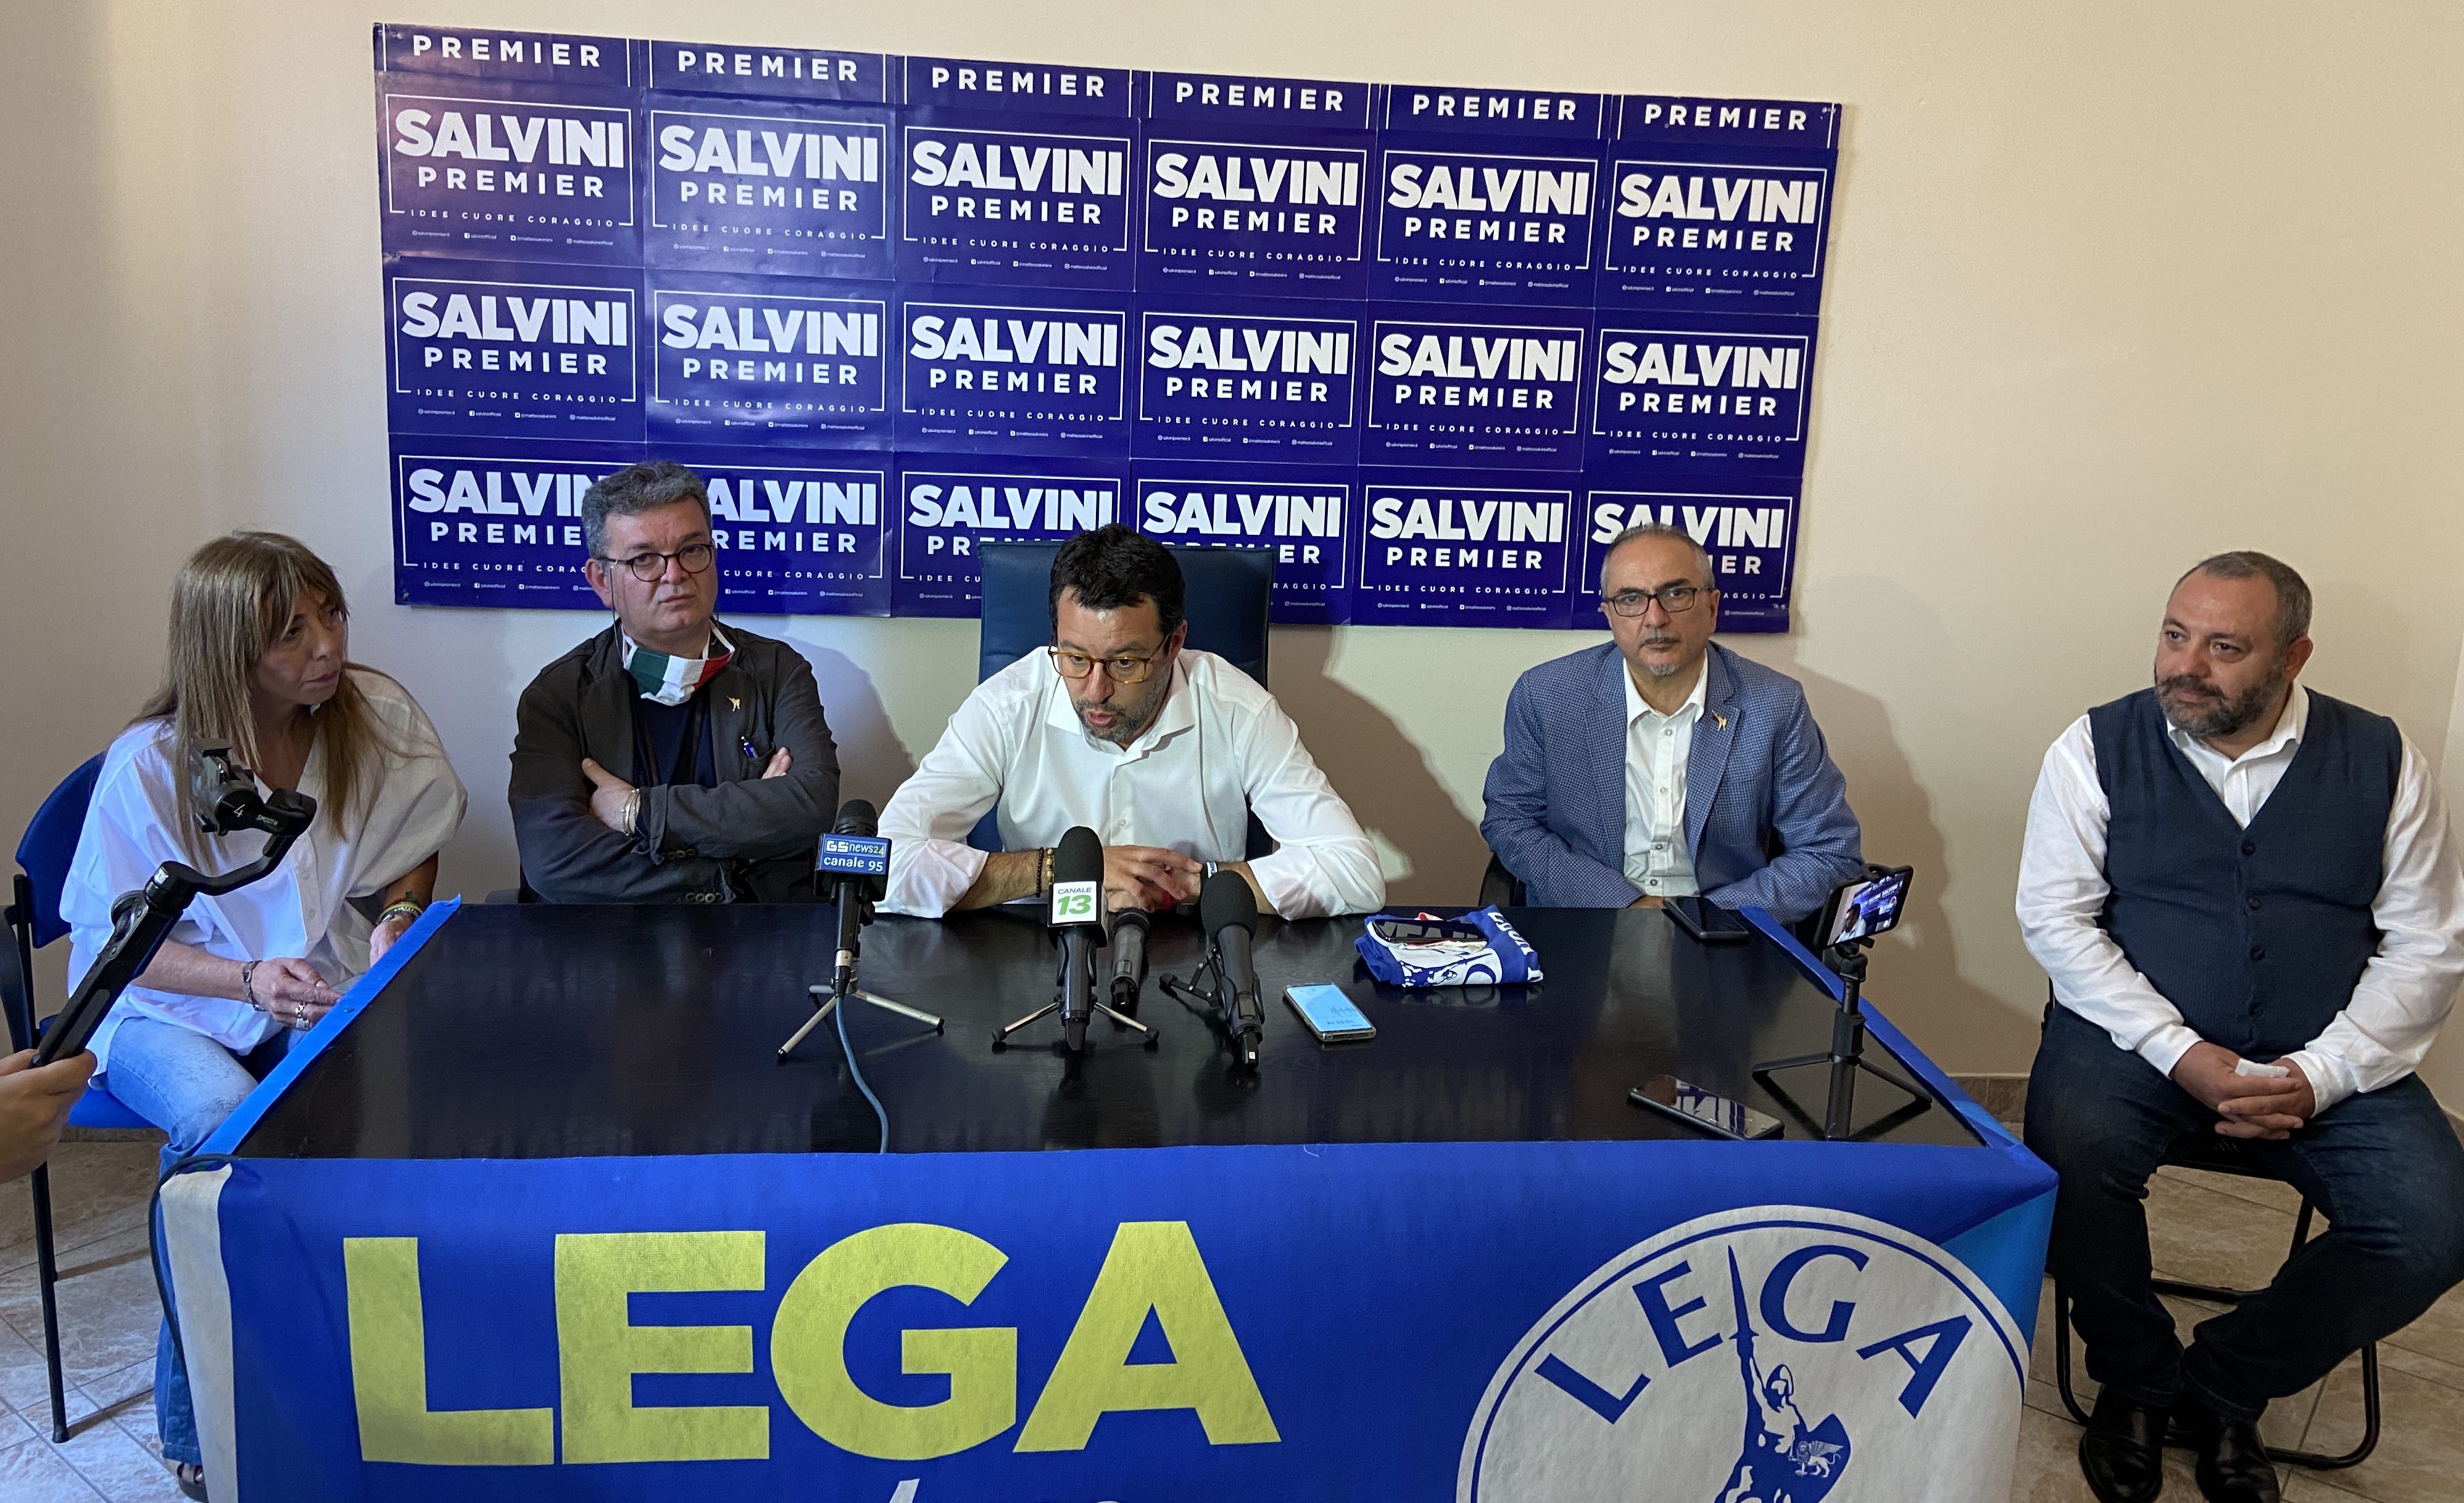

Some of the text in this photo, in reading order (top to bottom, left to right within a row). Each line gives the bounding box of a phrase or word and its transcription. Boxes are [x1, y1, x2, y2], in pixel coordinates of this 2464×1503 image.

[413, 35, 599, 67] PREMIER
[679, 51, 857, 81] PREMIER
[933, 68, 1103, 96] PREMIER
[1177, 83, 1342, 110] PREMIER
[1413, 95, 1575, 120] PREMIER
[1645, 104, 1806, 130] PREMIER
[394, 109, 623, 168] SALVINI
[658, 125, 877, 182] SALVINI
[911, 140, 1122, 196] SALVINI
[1153, 153, 1358, 206] SALVINI
[418, 166, 603, 197] PREMIER
[1387, 164, 1589, 215] SALVINI
[681, 181, 857, 211] PREMIER
[1617, 173, 1818, 224] SALVINI
[411, 209, 612, 226] IDEE CUORE CORAGGIO
[931, 195, 1100, 224] PREMIER
[1172, 207, 1336, 234] PREMIER
[673, 223, 865, 240] IDEE CUORE CORAGGIO
[1405, 217, 1566, 243] PREMIER
[1633, 226, 1793, 251] PREMIER
[923, 237, 1108, 252] IDEE CUORE CORAGGIO
[1208, 250, 1255, 259] CUORE
[1266, 252, 1342, 262] CORAGGIO
[1439, 259, 1485, 267] CUORE
[1496, 261, 1570, 270] CORAGGIO
[1623, 265, 1796, 279] IDEE CUORE CORAGGIO
[402, 291, 627, 346] SALVINI
[662, 304, 877, 357] SALVINI
[910, 315, 1117, 366] SALVINI
[1148, 325, 1349, 375] SALVINI
[425, 347, 606, 375] PREMIER
[1378, 333, 1575, 382] SALVINI
[1603, 341, 1799, 389] SALVINI
[683, 358, 857, 384] PREMIER
[930, 368, 1096, 394] PREMIER
[417, 389, 615, 403] IDEE CUORE CORAGGIO
[1166, 377, 1327, 402] PREMIER
[1395, 384, 1553, 408] PREMIER
[675, 399, 865, 412] IDEE CUORE CORAGGIO
[968, 410, 1014, 418] CUORE
[1026, 412, 1103, 421] CORAGGIO
[1619, 392, 1776, 416] PREMIER
[1202, 418, 1248, 426] CUORE
[1259, 420, 1334, 428] CORAGGIO
[1429, 424, 1474, 433] CUORE
[1485, 426, 1558, 435] CORAGGIO
[1652, 431, 1696, 439] CUORE
[1707, 433, 1780, 442] CORAGGIO
[409, 468, 611, 518] SALVI
[707, 478, 876, 525] ALVINI
[908, 484, 1113, 532] SALVINI
[1143, 491, 1341, 537] SALVINI
[1369, 497, 1564, 542] SALVINI
[431, 521, 581, 545] PREMIE
[711, 529, 855, 552] REMIER
[473, 563, 523, 571] CUORE
[1387, 547, 1542, 569] PREMIER
[724, 569, 863, 579] CUORE CORAGGIO
[1475, 587, 1547, 595] CORAGGIO
[233, 804, 246, 818] 4
[824, 856, 883, 872] canale 95
[1057, 895, 1092, 916] 13
[342, 1220, 1282, 1466] LEGA
[1534, 1244, 1973, 1425] LEGA
